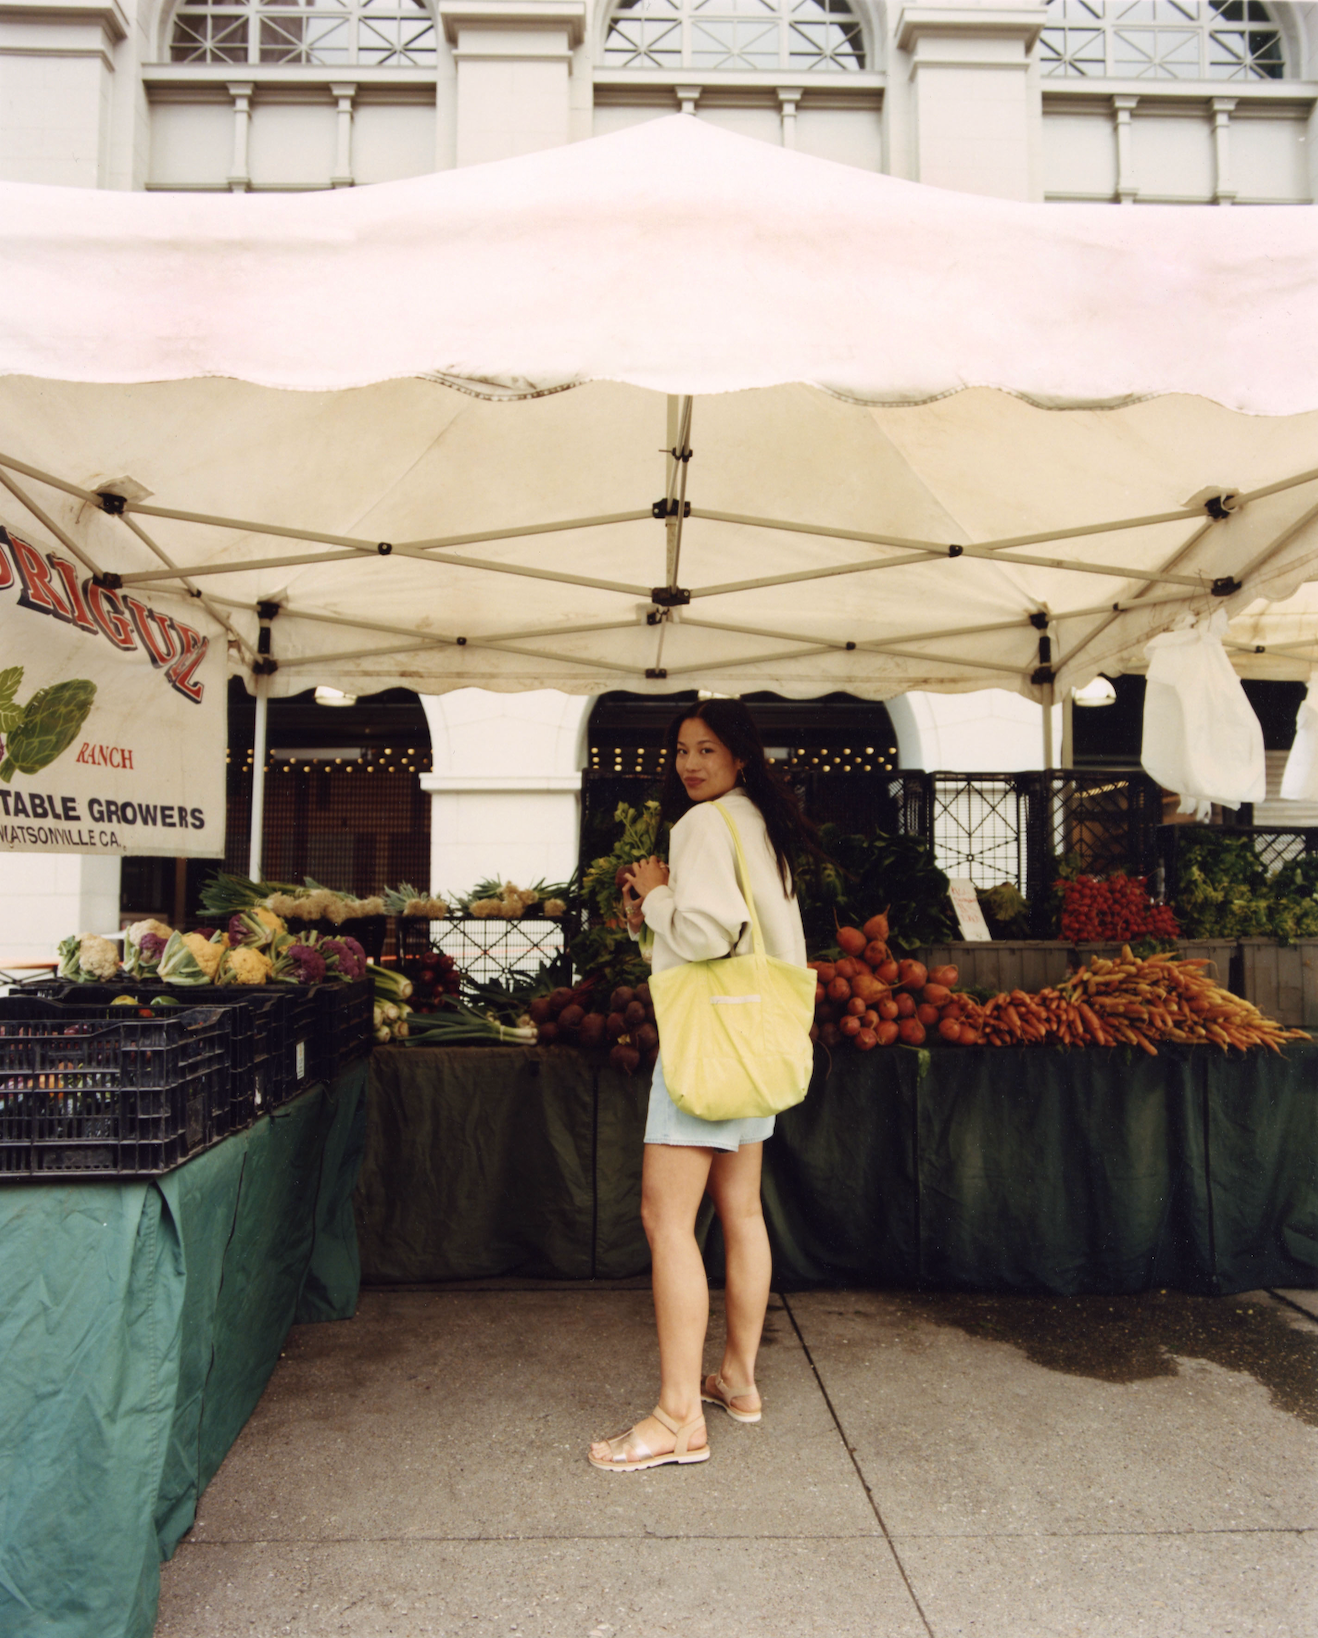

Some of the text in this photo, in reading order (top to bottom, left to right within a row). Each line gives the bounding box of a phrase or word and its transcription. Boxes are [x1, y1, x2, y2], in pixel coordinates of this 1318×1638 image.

[76, 742, 134, 770] RANCH
[0, 789, 205, 830] TABLE GROWERS
